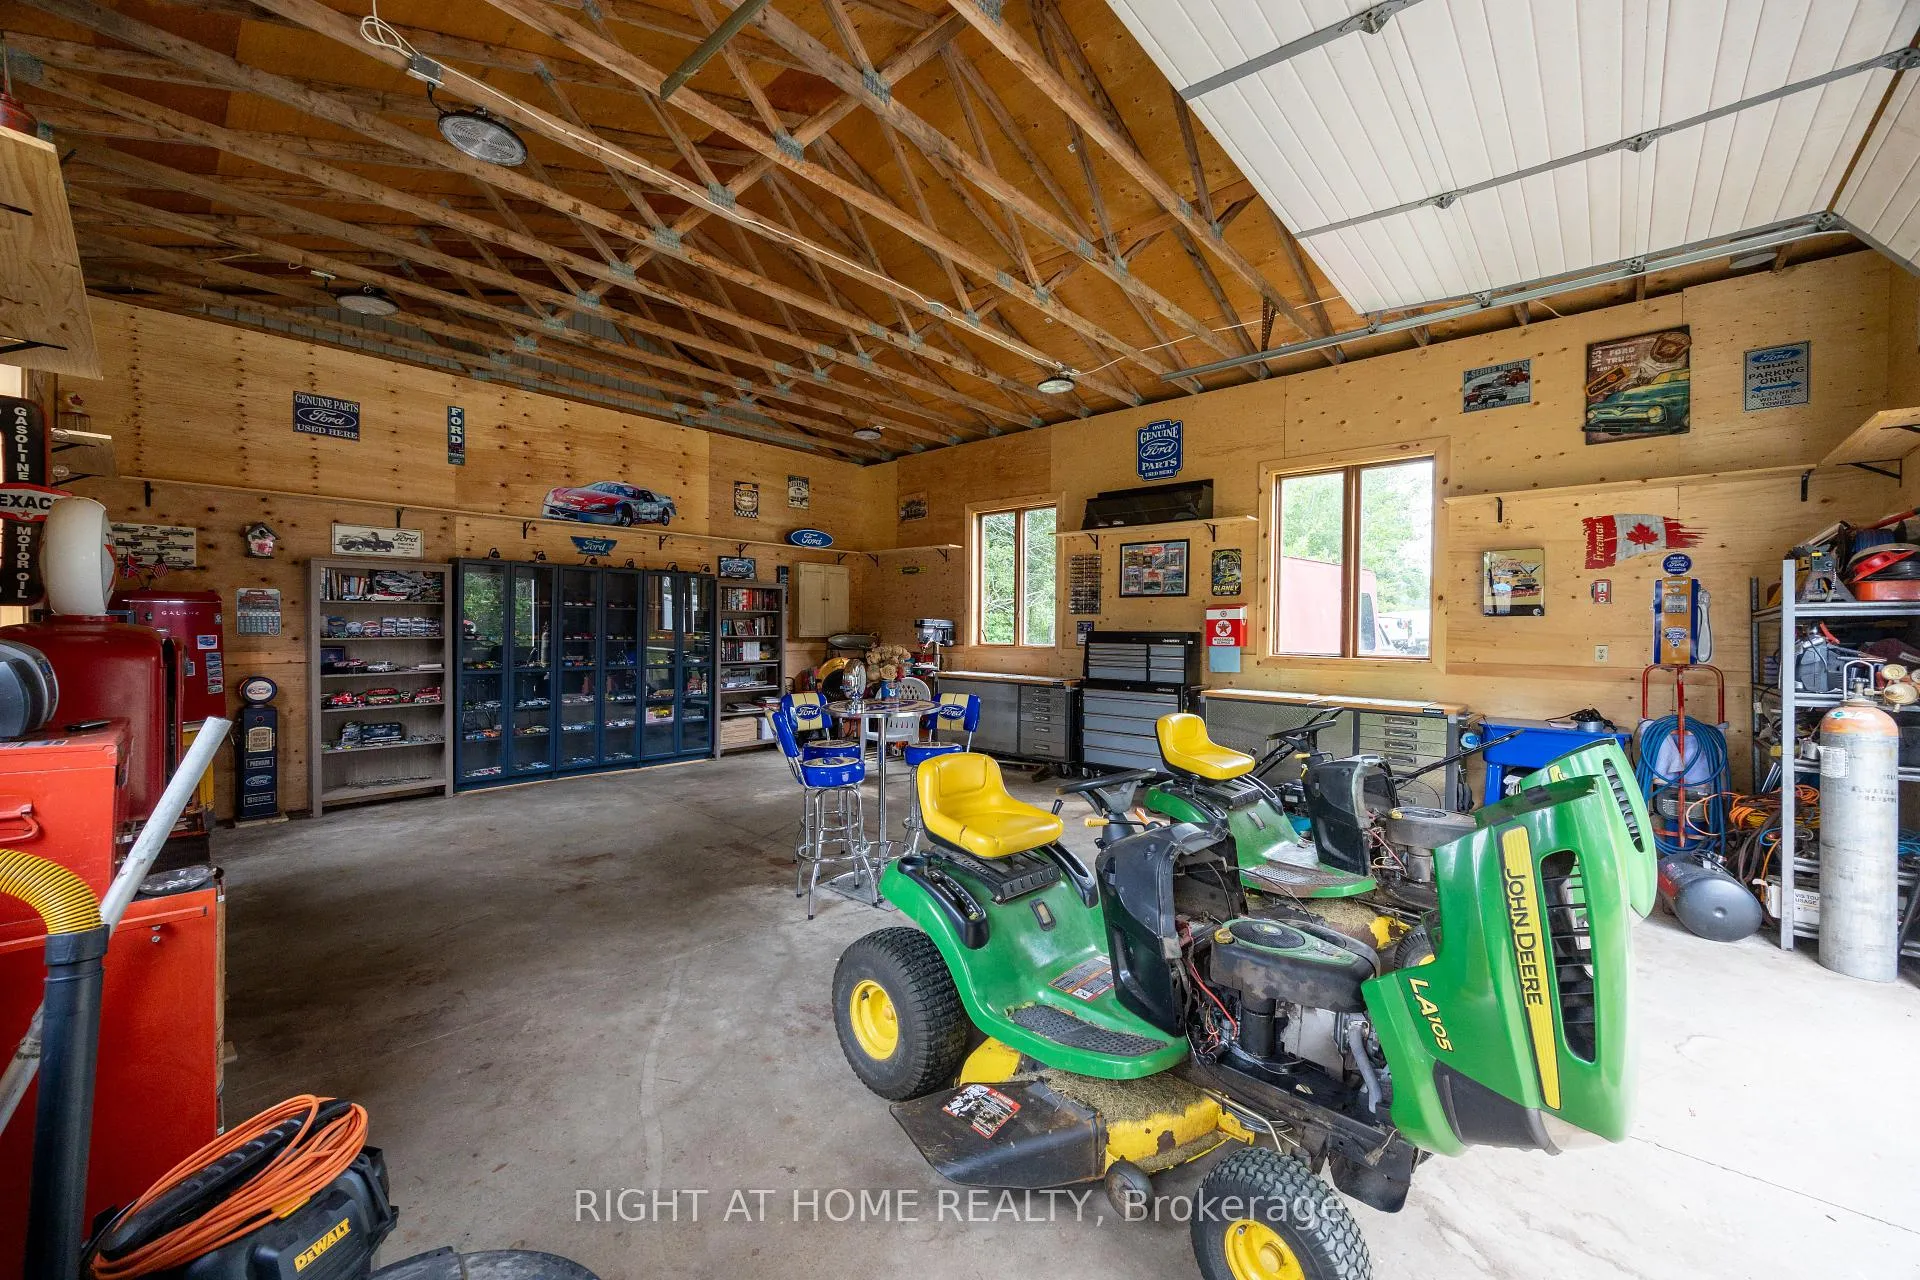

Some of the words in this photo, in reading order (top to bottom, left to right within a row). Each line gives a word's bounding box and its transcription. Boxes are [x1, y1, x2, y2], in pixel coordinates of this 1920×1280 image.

[1605, 353, 1638, 364] TRUCK
[1609, 346, 1635, 357] FORD
[1760, 350, 1792, 362] Ford
[1754, 360, 1800, 370] TRUCK
[1748, 366, 1805, 380] PARKING
[1760, 374, 1793, 385] ONLY
[295, 393, 333, 409] GENUINE
[333, 400, 359, 413] PARTS
[309, 409, 345, 426] Ford
[296, 423, 326, 434] USED
[450, 407, 463, 444] FORD
[1140, 425, 1179, 444] GENUINE
[13, 406, 30, 481] GASOLINE
[1143, 442, 1175, 457] Ford
[1141, 457, 1178, 471] PARTS
[0, 493, 58, 510] EXAC
[392, 532, 419, 543] Ford
[801, 532, 823, 545] Ford
[16, 526, 32, 569] MOTOR
[582, 539, 607, 552] Ford
[727, 562, 748, 573] Ford
[16, 572, 30, 599] OIL
[797, 706, 819, 716] Ford
[940, 706, 964, 717] Ford
[1505, 868, 1531, 929] JOHN
[1515, 932, 1544, 1007] DEERE
[1408, 977, 1455, 1052] LA105
[294, 1217, 352, 1273] DEWALT
